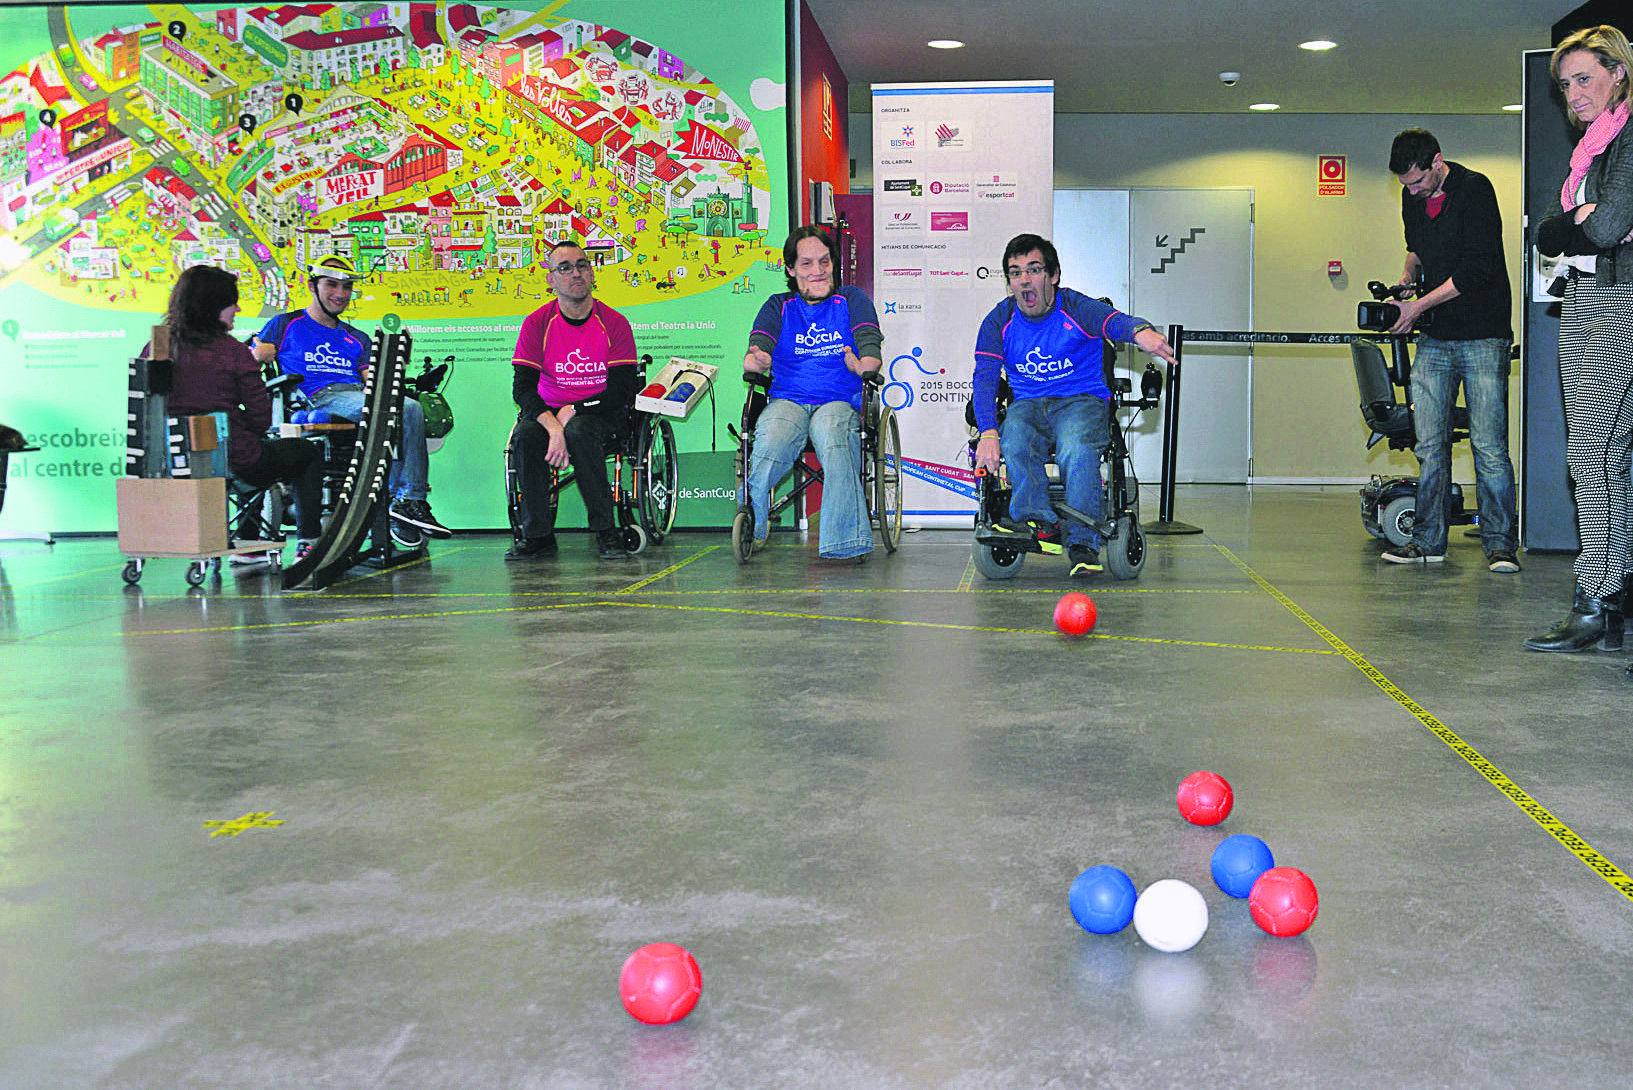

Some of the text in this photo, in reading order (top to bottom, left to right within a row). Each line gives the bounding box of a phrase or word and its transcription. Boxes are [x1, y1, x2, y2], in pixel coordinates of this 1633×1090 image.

[173, 25, 181, 34] 2
[534, 82, 573, 125] Voltes
[243, 117, 251, 128] 3
[890, 138, 915, 147] BISFed
[326, 171, 377, 196] MERCAT
[329, 187, 373, 206] VELL
[387, 272, 468, 290] SANTIAGO
[388, 317, 394, 327] 3
[444, 324, 456, 333] els
[457, 325, 492, 333] accessos
[651, 321, 659, 330] el
[661, 321, 686, 330] Teatre
[687, 321, 696, 330] la
[696, 320, 716, 330] Unió
[796, 331, 843, 346] BOCCIA
[304, 351, 352, 368] BOCCIA
[1015, 357, 1074, 375] BOCCIA
[555, 361, 607, 374] BOCCIA
[920, 381, 974, 390] 2015 BOCC
[920, 392, 970, 403] CONTIN
[26, 427, 127, 447] escobreix
[10, 457, 28, 478] al
[35, 458, 104, 478] centre
[925, 465, 976, 480] SANT CUGAT SAN
[679, 486, 736, 501] de SantCug
